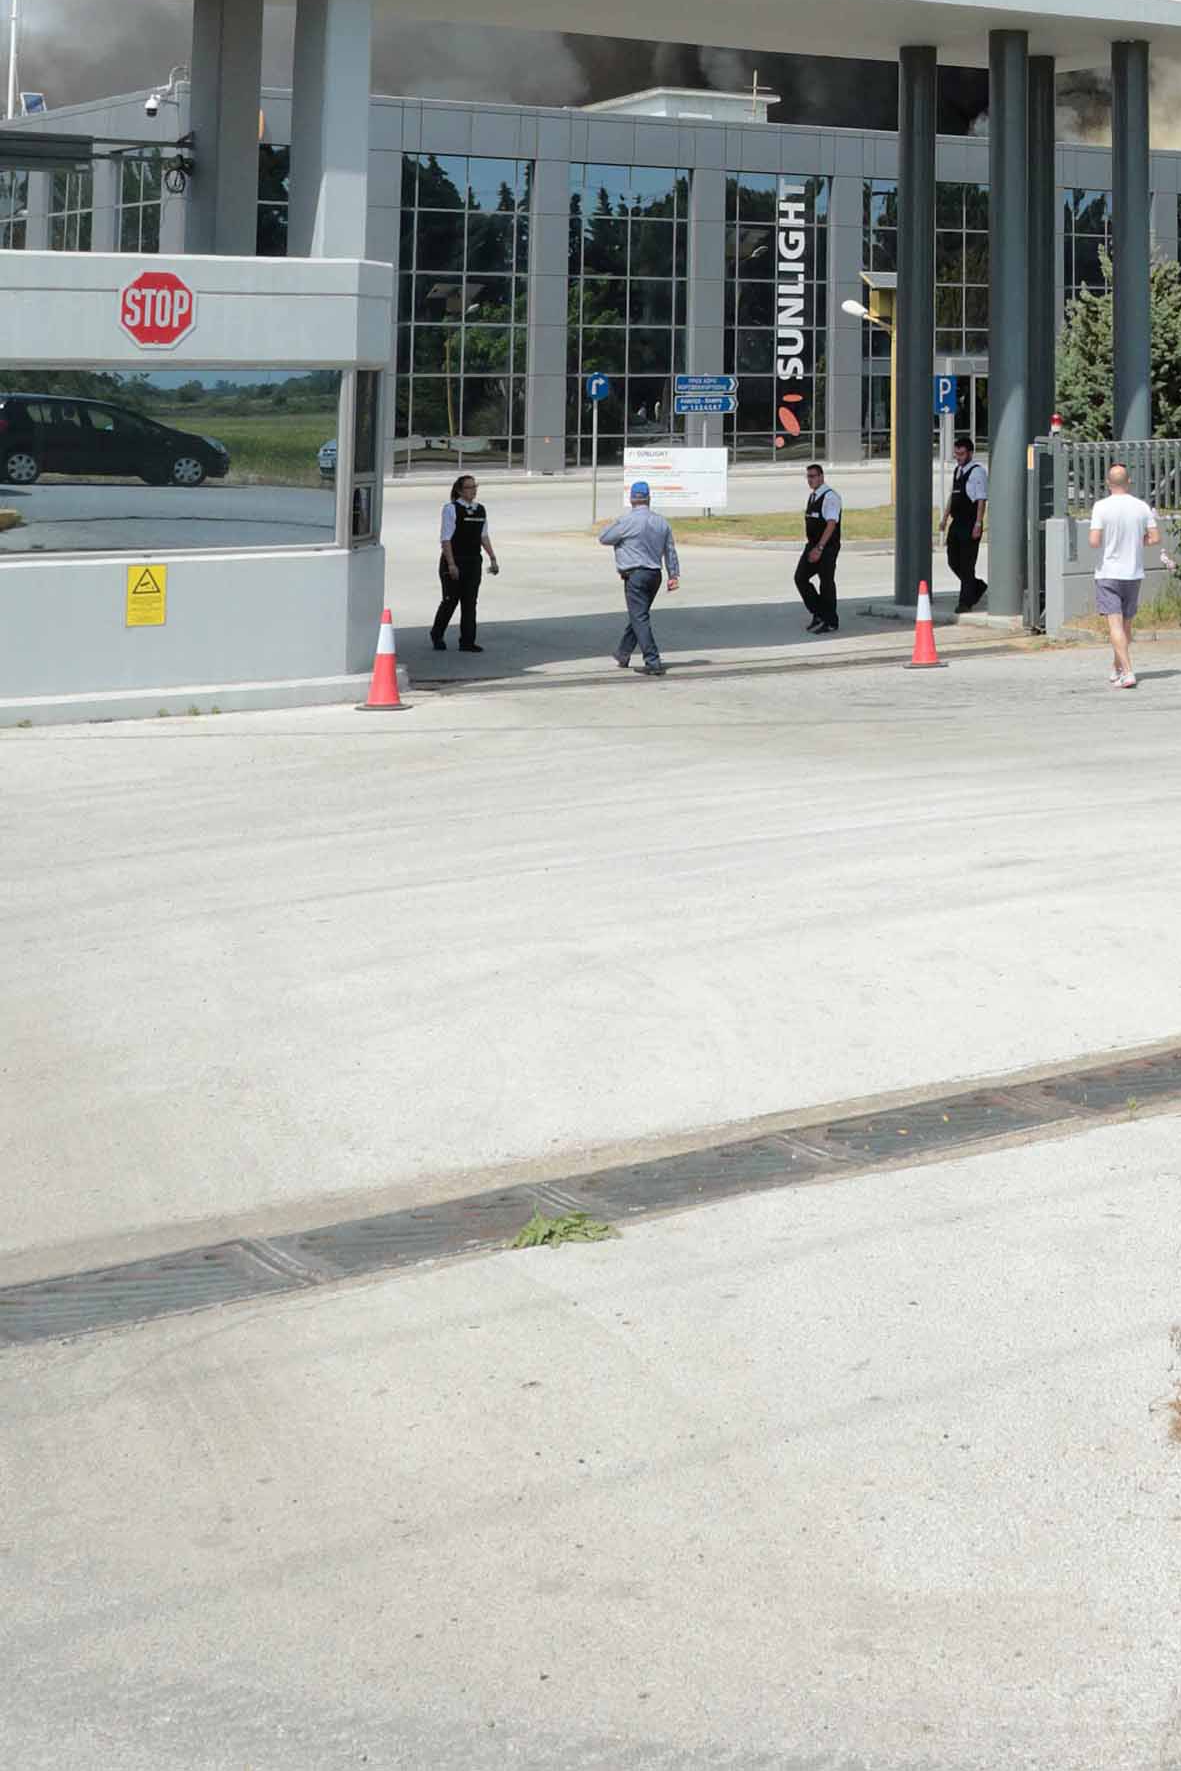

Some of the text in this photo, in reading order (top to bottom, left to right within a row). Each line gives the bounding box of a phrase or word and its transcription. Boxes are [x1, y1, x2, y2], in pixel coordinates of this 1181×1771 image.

[777, 178, 805, 381] SUNLIGHT
[124, 288, 190, 327] STOP
[939, 378, 951, 403] P
